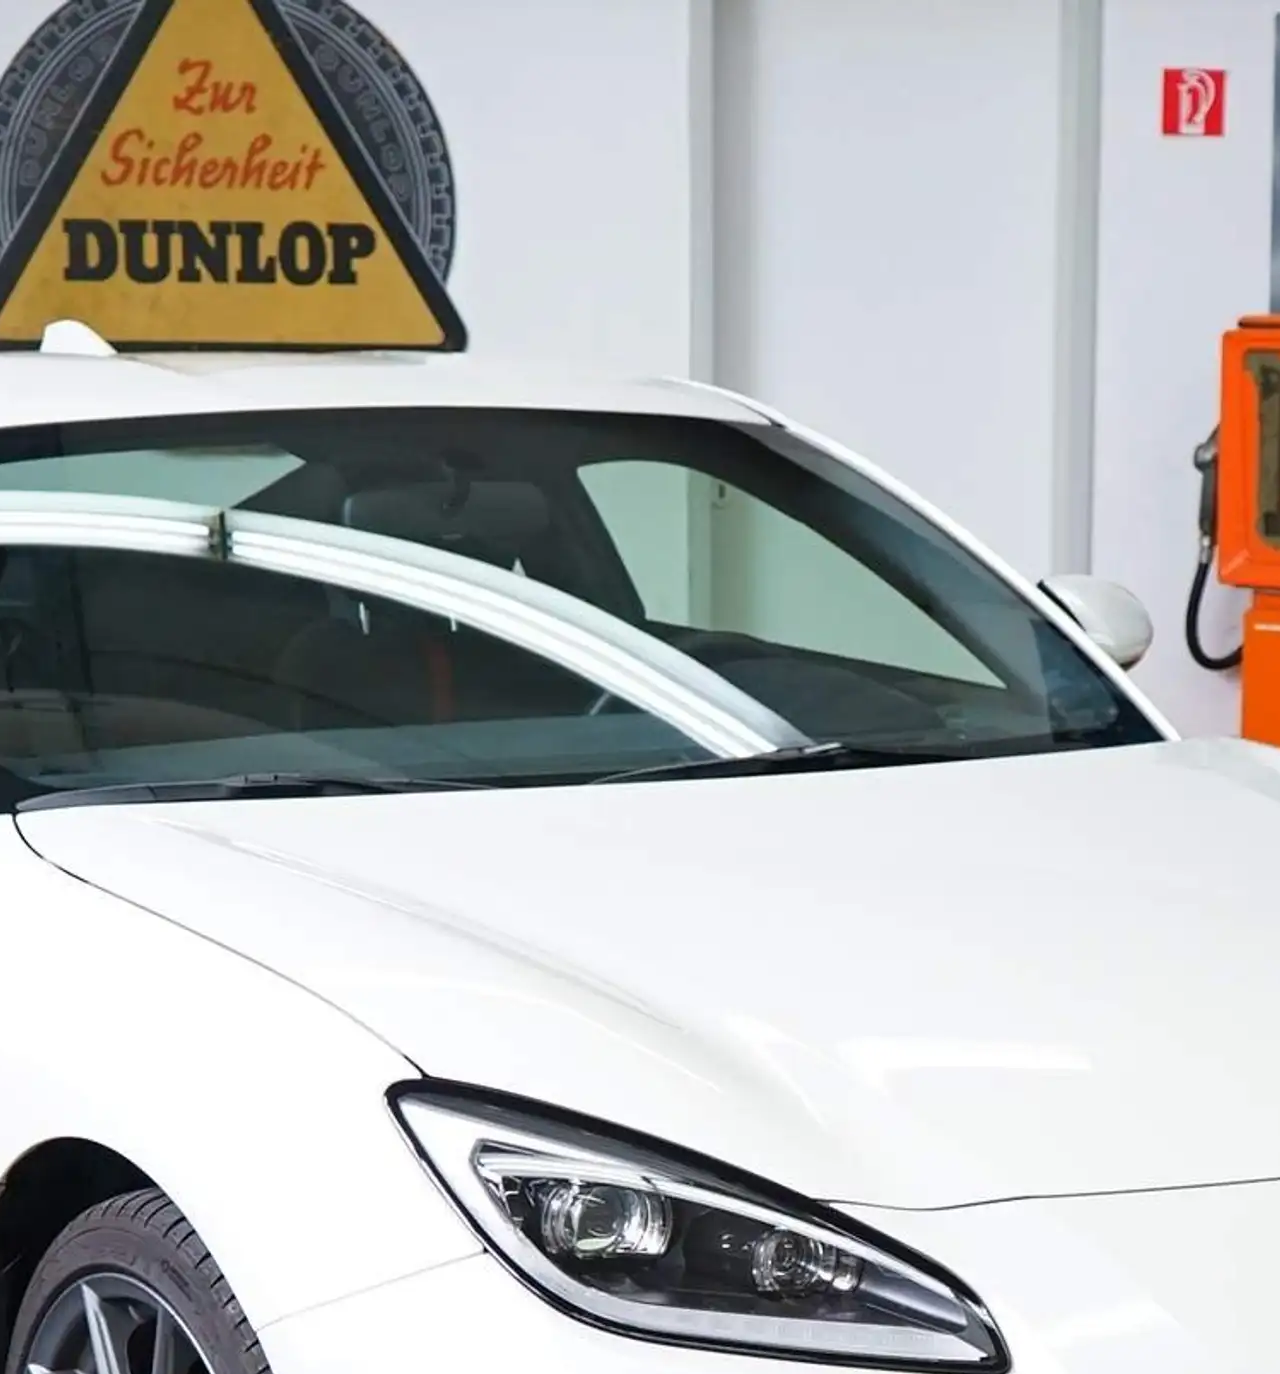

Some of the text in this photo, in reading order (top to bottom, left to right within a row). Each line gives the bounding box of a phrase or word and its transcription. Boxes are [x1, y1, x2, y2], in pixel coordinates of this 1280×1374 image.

[173, 57, 257, 116] Zur
[100, 128, 326, 191] Sicherheit
[62, 217, 376, 285] DUNLOP
